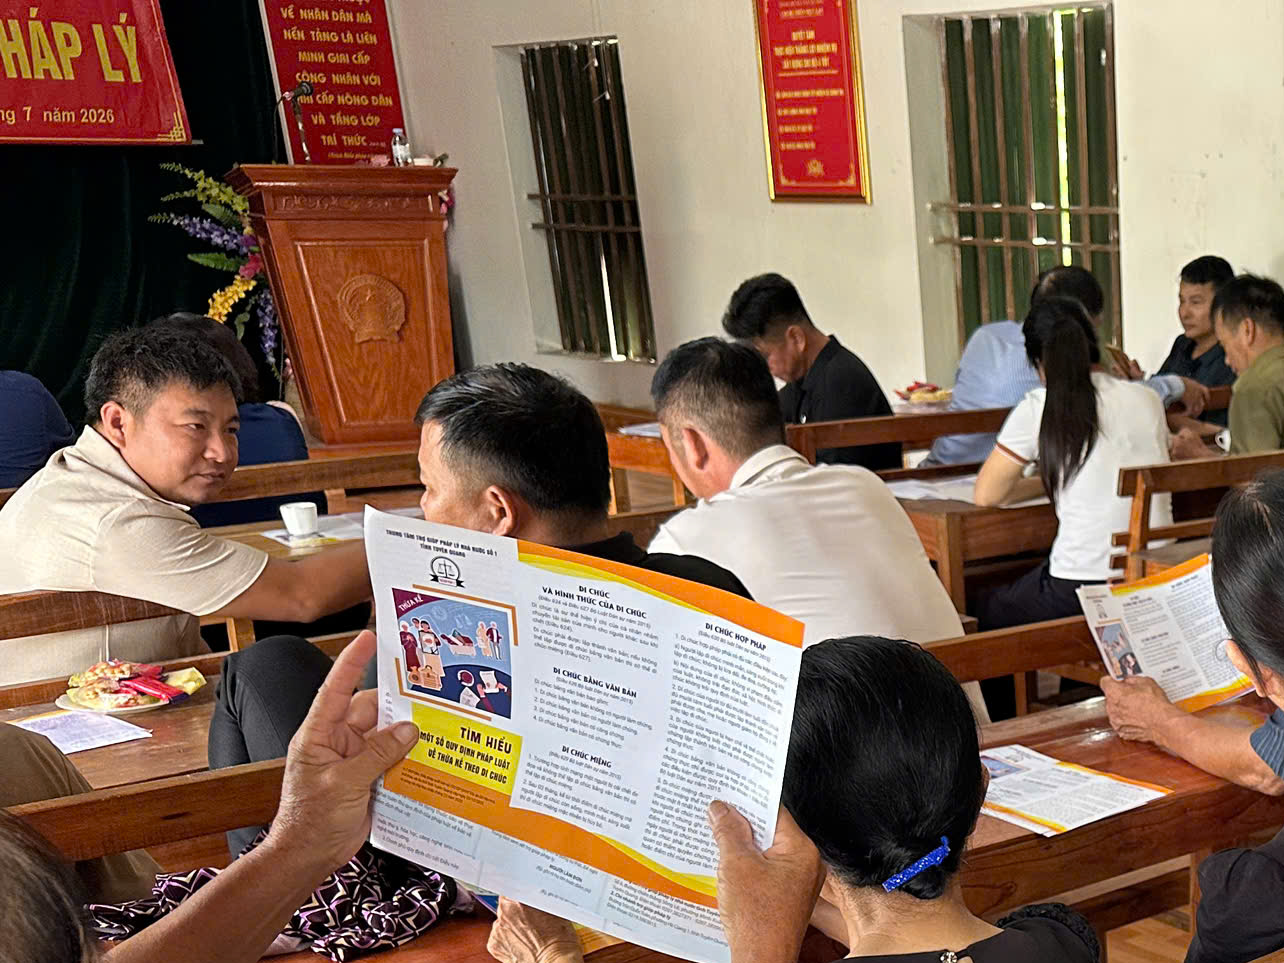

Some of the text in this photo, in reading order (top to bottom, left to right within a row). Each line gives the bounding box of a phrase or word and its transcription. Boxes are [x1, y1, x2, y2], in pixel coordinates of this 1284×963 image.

[280, 4, 373, 24] VỀ NHÂN DÂN MÀ
[283, 26, 378, 45] NỀN TẢNG LÀ LIÊN
[92, 12, 142, 83] LÝ
[298, 50, 371, 65] MINH GIAI CẤP
[295, 69, 381, 86] CÔNG NHÂN VỚI
[316, 90, 334, 105] CẤP
[338, 94, 369, 106] NÔNG
[372, 95, 393, 108] DÂN
[23, 106, 32, 121] 7
[43, 107, 76, 123] năm
[80, 108, 115, 123] 2026
[311, 111, 380, 127] VÀ TẦNG LỚP
[321, 132, 337, 146] TRÍ
[342, 134, 367, 147] THỨC
[542, 586, 553, 595] VÀ
[555, 588, 574, 600] HÌNH
[576, 593, 597, 606] THỨC
[599, 598, 614, 611] CỦA
[626, 607, 647, 619] CHÚC
[588, 588, 610, 599] CHÚC
[714, 625, 733, 638] CHÚC
[735, 633, 749, 644] HỢP
[750, 639, 767, 651] PHÁP
[562, 669, 582, 681] CHÚC
[583, 675, 604, 688] BẰNG
[605, 681, 620, 693] VĂN
[621, 687, 637, 698] BẢN
[460, 726, 512, 754] TÌM HIỂU
[420, 731, 510, 770] MỘT SỐ QUY ĐỊNH PHÁP LUẬT
[570, 748, 589, 760] CHÚC
[590, 755, 612, 769] MIỆNG
[428, 748, 436, 759] VỀ
[438, 752, 453, 764] THỪA
[454, 757, 463, 769] KẾ
[464, 761, 480, 774] THEO
[489, 770, 507, 784] CHÚC
